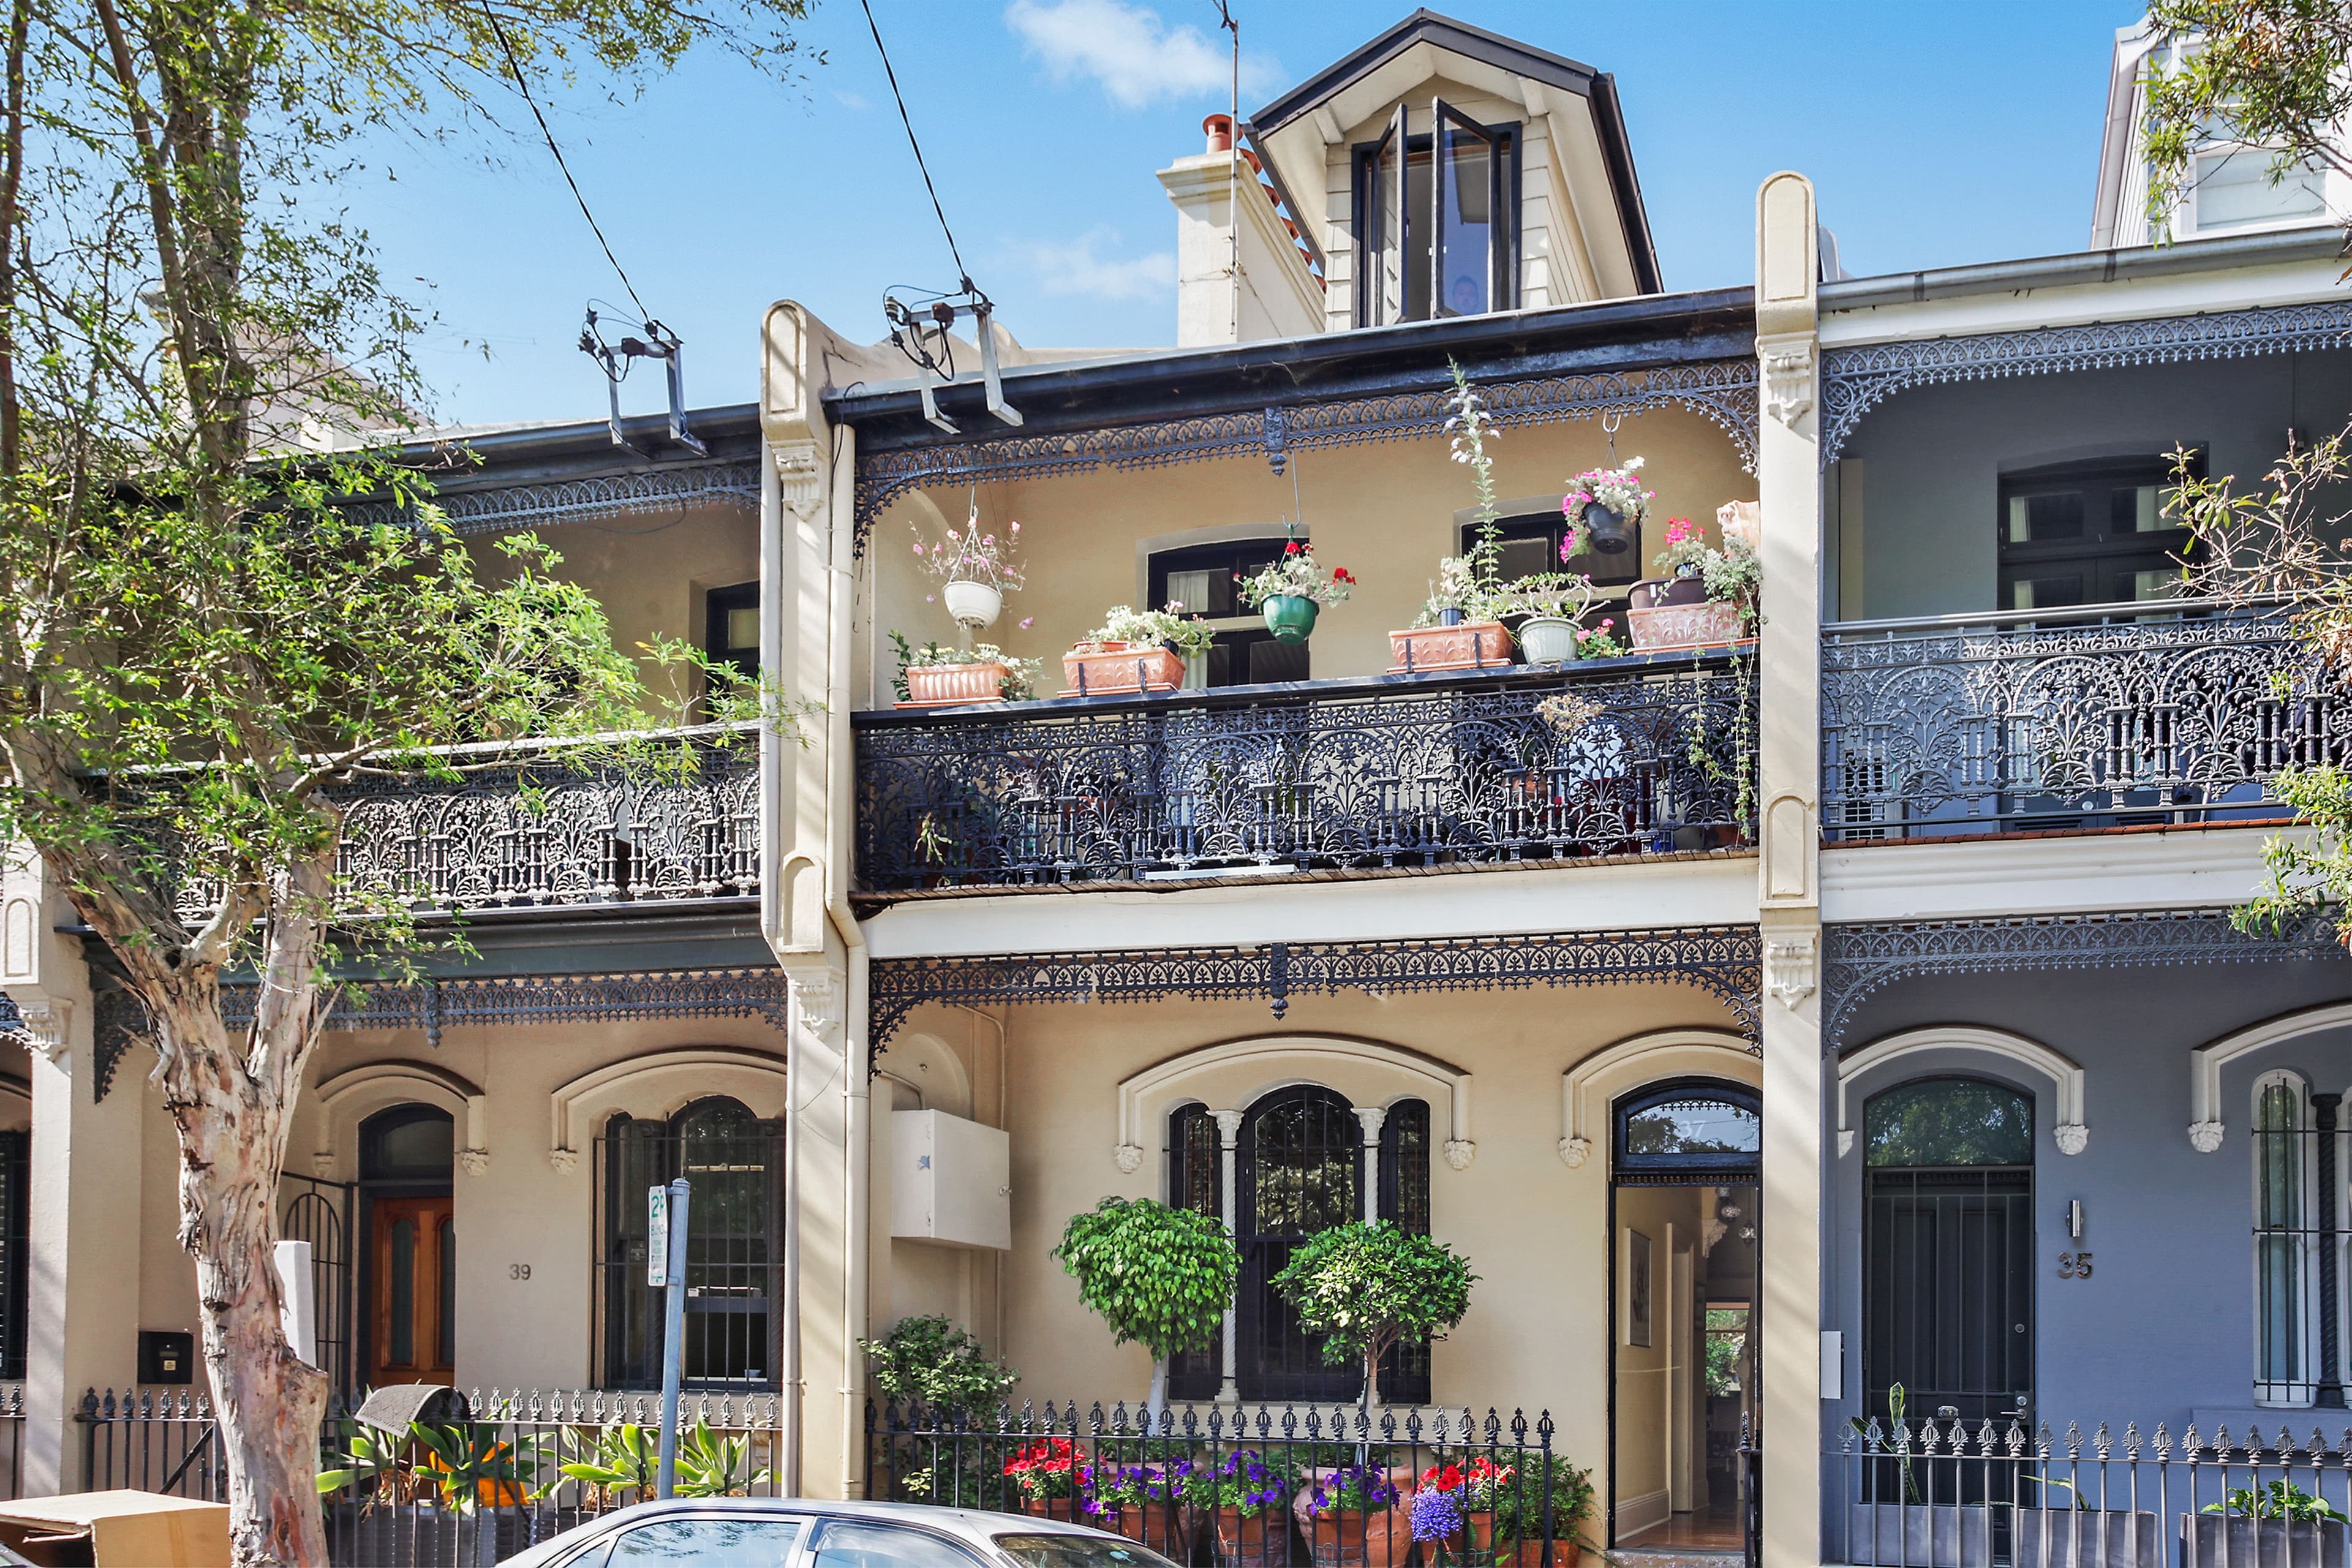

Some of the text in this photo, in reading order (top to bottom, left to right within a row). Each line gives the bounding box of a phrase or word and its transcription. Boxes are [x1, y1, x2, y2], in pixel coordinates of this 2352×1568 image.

[1676, 1120, 1706, 1138] 37
[652, 1195, 665, 1218] 2P
[509, 1264, 531, 1280] 39
[2058, 1251, 2092, 1279] 35
